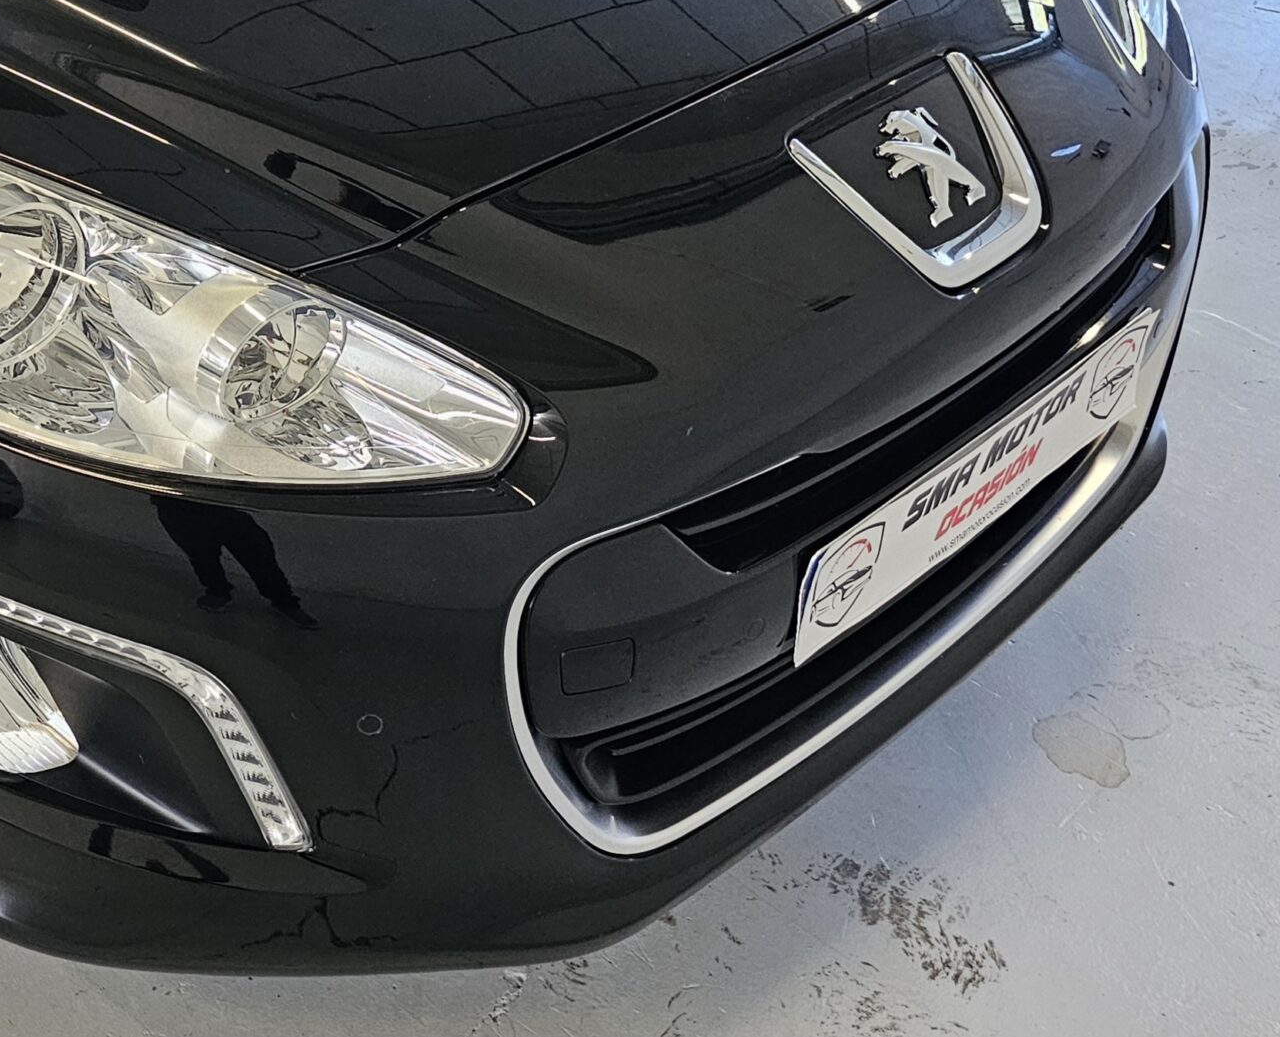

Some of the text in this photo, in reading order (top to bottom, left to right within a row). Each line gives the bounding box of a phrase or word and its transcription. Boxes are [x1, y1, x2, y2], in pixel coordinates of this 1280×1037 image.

[901, 370, 1087, 533] SMA MOTOR
[933, 437, 1043, 542] OCASIÓN
